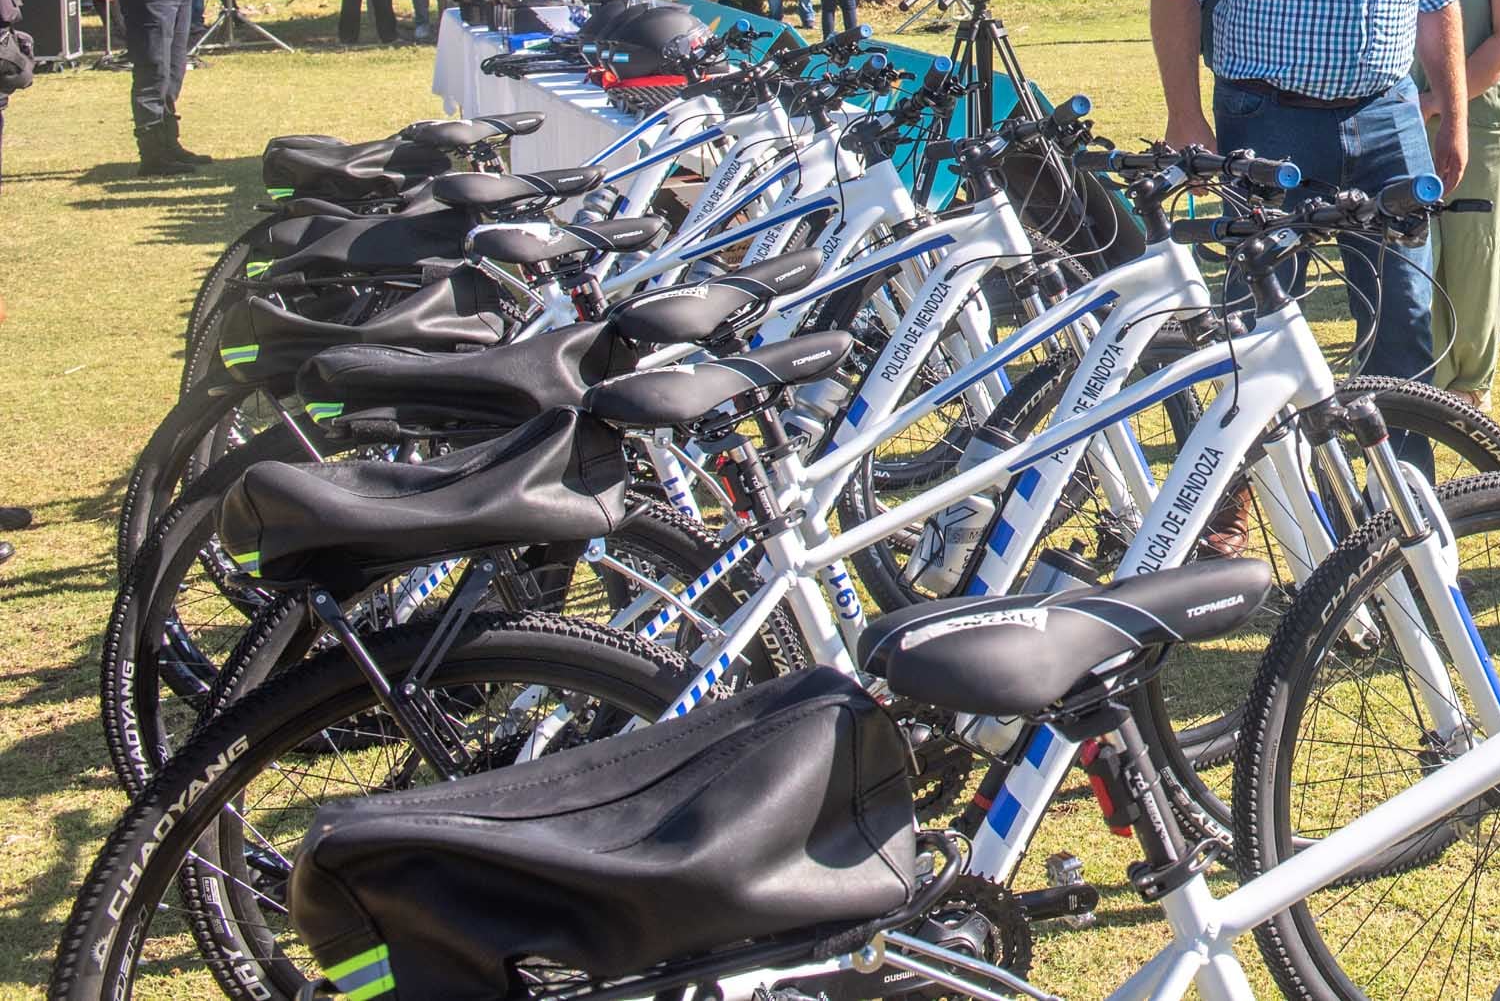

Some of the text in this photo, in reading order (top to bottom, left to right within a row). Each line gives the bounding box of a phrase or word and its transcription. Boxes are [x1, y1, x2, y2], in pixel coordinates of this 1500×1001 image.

[716, 160, 741, 192] MENDOZA
[752, 243, 773, 264] OLICÍA
[792, 350, 832, 367] TOPMEGA
[881, 282, 952, 383] POLICÍA DE MENDOZA
[1082, 343, 1124, 400] MENDOZA
[1136, 447, 1224, 575] OLICÍA DE MENDOZA
[827, 564, 861, 620] (91
[1186, 594, 1245, 618] TOPMEGA
[1321, 537, 1400, 625] CHAOYA
[120, 660, 153, 786] HAOYANG
[107, 735, 250, 921] CHAOYANG
[884, 970, 919, 983] IMANO
